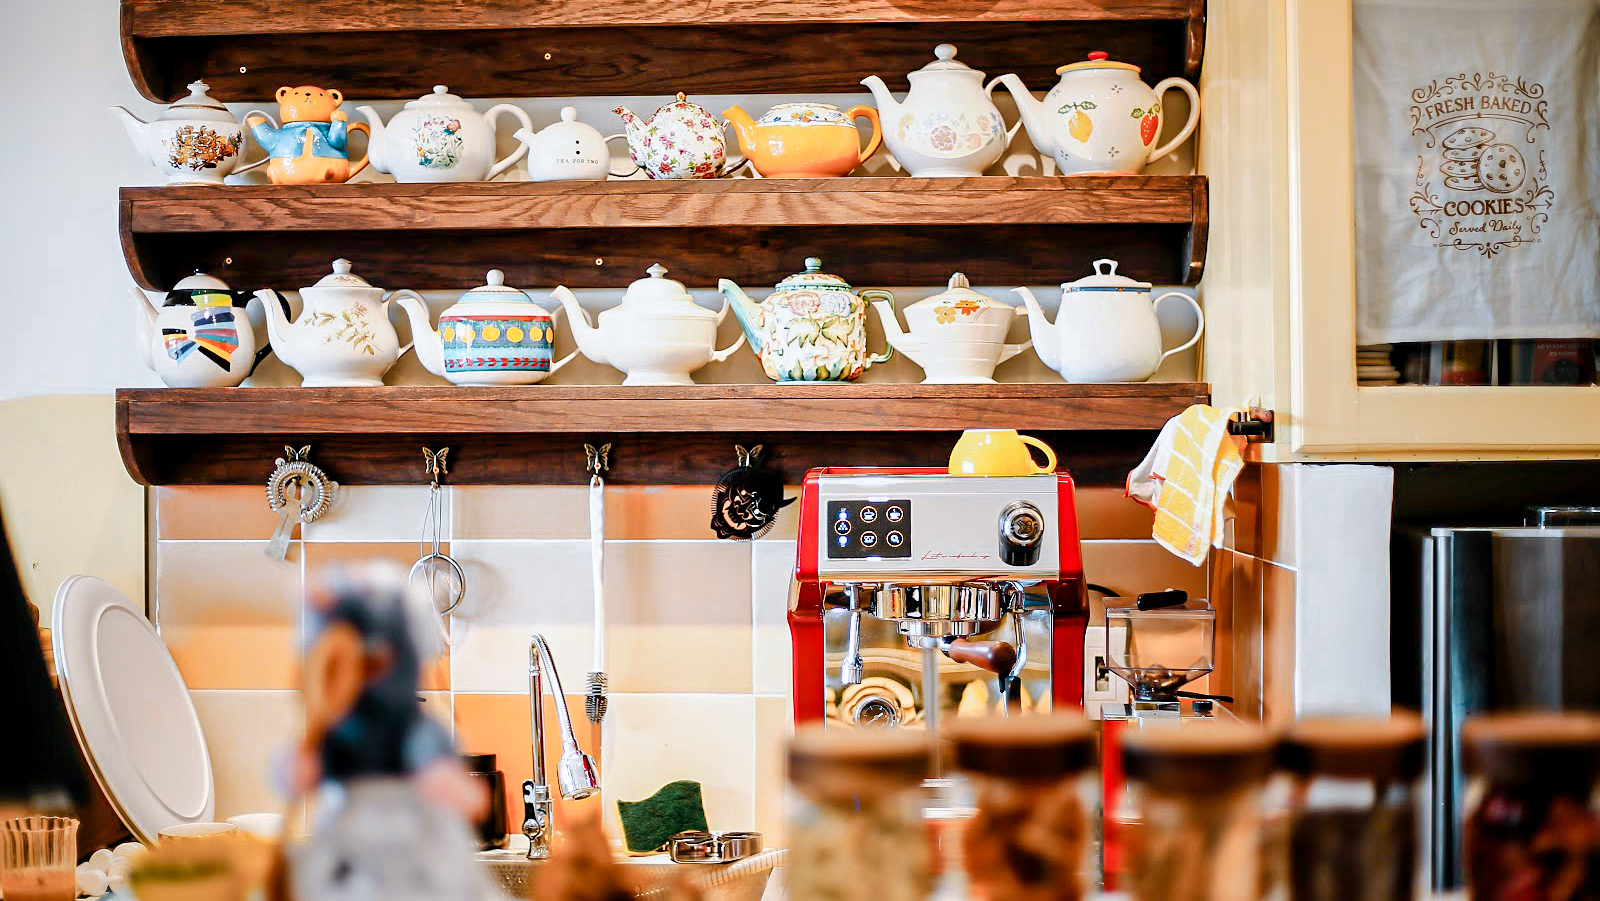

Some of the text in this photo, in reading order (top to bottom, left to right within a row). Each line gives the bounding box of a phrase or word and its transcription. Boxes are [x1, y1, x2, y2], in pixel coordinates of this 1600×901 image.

[1424, 95, 1532, 120] FRESH BAKED
[1443, 198, 1525, 217] COOKIES
[1449, 219, 1522, 235] Served Daily
